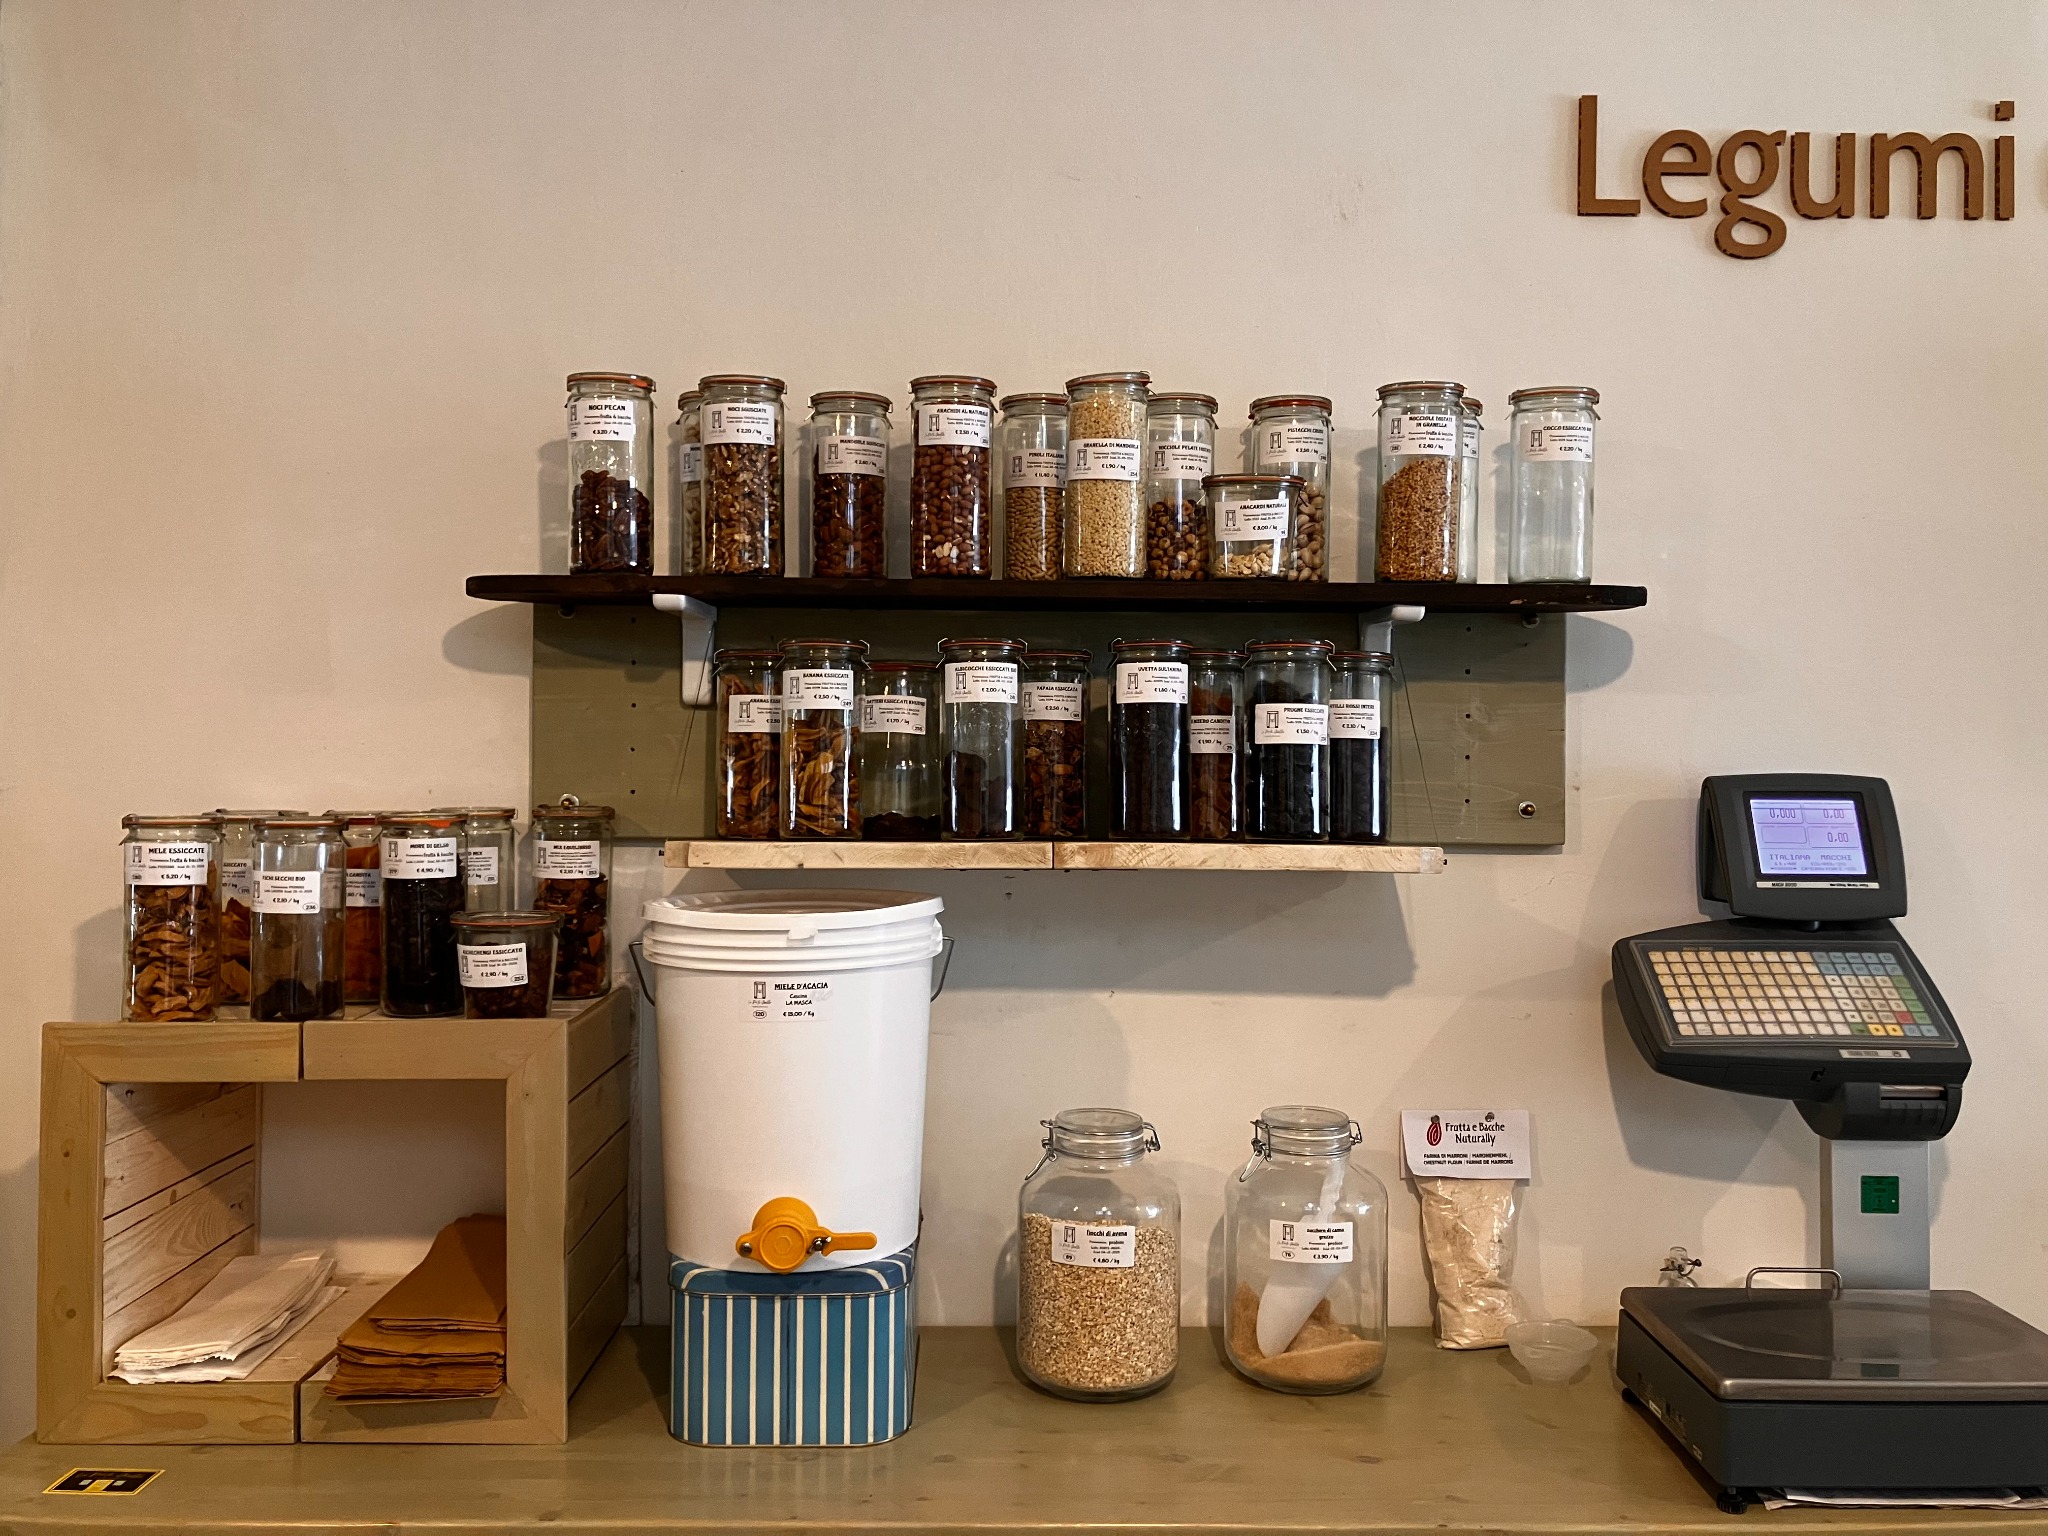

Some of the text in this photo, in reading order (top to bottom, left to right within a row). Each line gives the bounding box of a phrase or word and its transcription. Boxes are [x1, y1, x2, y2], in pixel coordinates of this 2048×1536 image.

[1577, 94, 2015, 260] Legumi
[1769, 808, 1845, 819] 0,000 0,00
[1827, 832, 1849, 843] 0,00
[1769, 853, 1811, 861] ITALIANA
[492, 947, 523, 955] ESSICCATO
[774, 982, 829, 991] MIELE D'ACACIA
[1445, 1121, 1506, 1132] Frutta e Bacche
[1086, 1229, 1105, 1237] fiocchi
